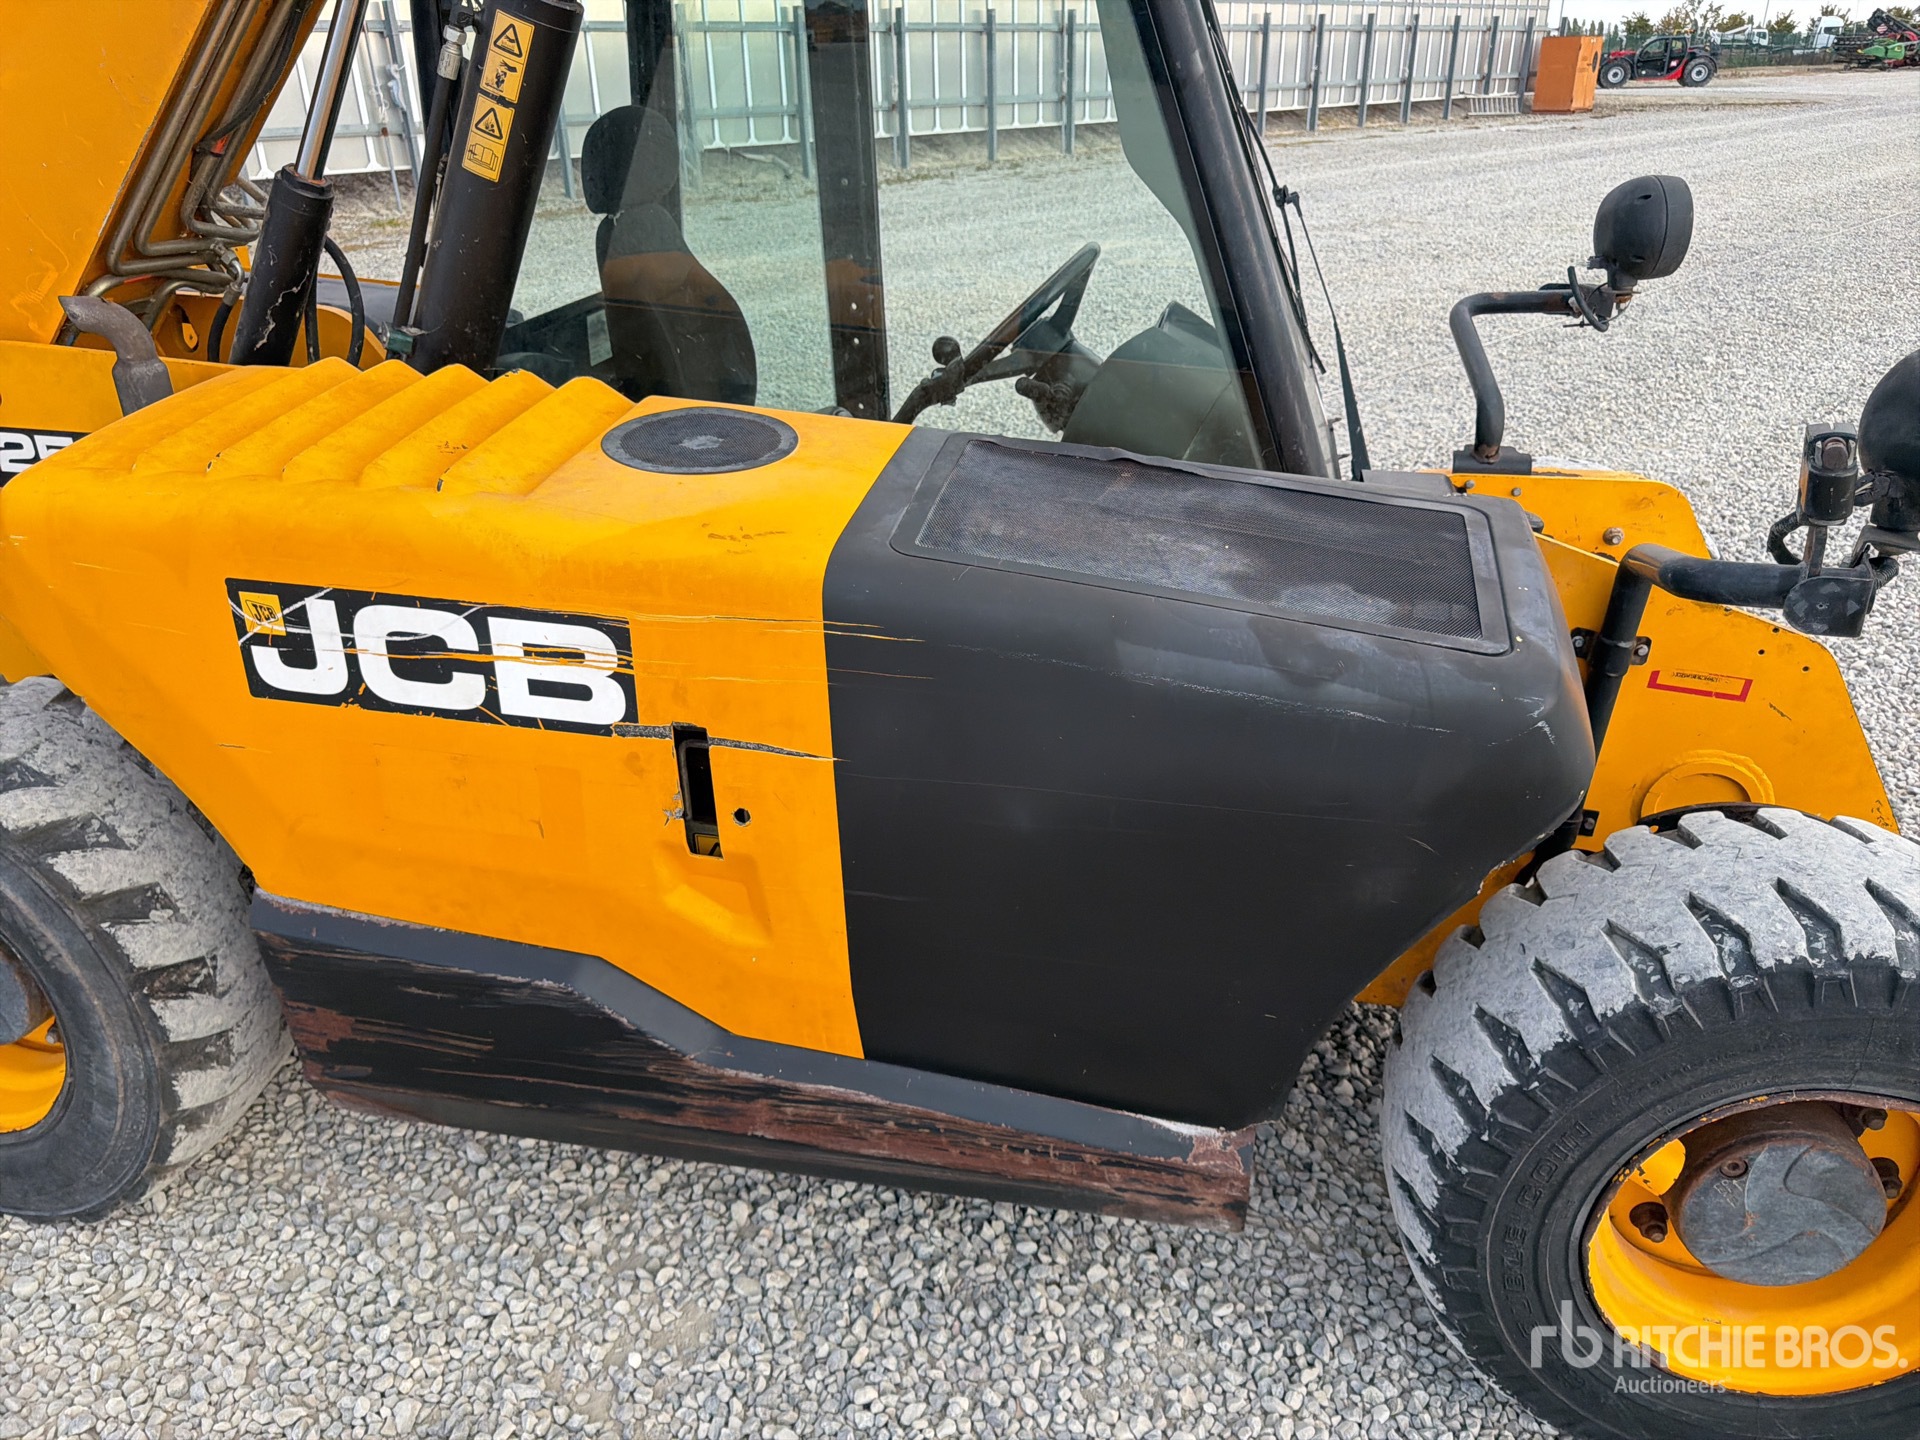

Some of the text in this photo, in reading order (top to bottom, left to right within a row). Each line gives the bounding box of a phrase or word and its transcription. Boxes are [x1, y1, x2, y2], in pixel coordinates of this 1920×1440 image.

[251, 603, 277, 622] JCB
[250, 598, 626, 725] JCB
[1516, 1120, 1593, 1209] COIN
